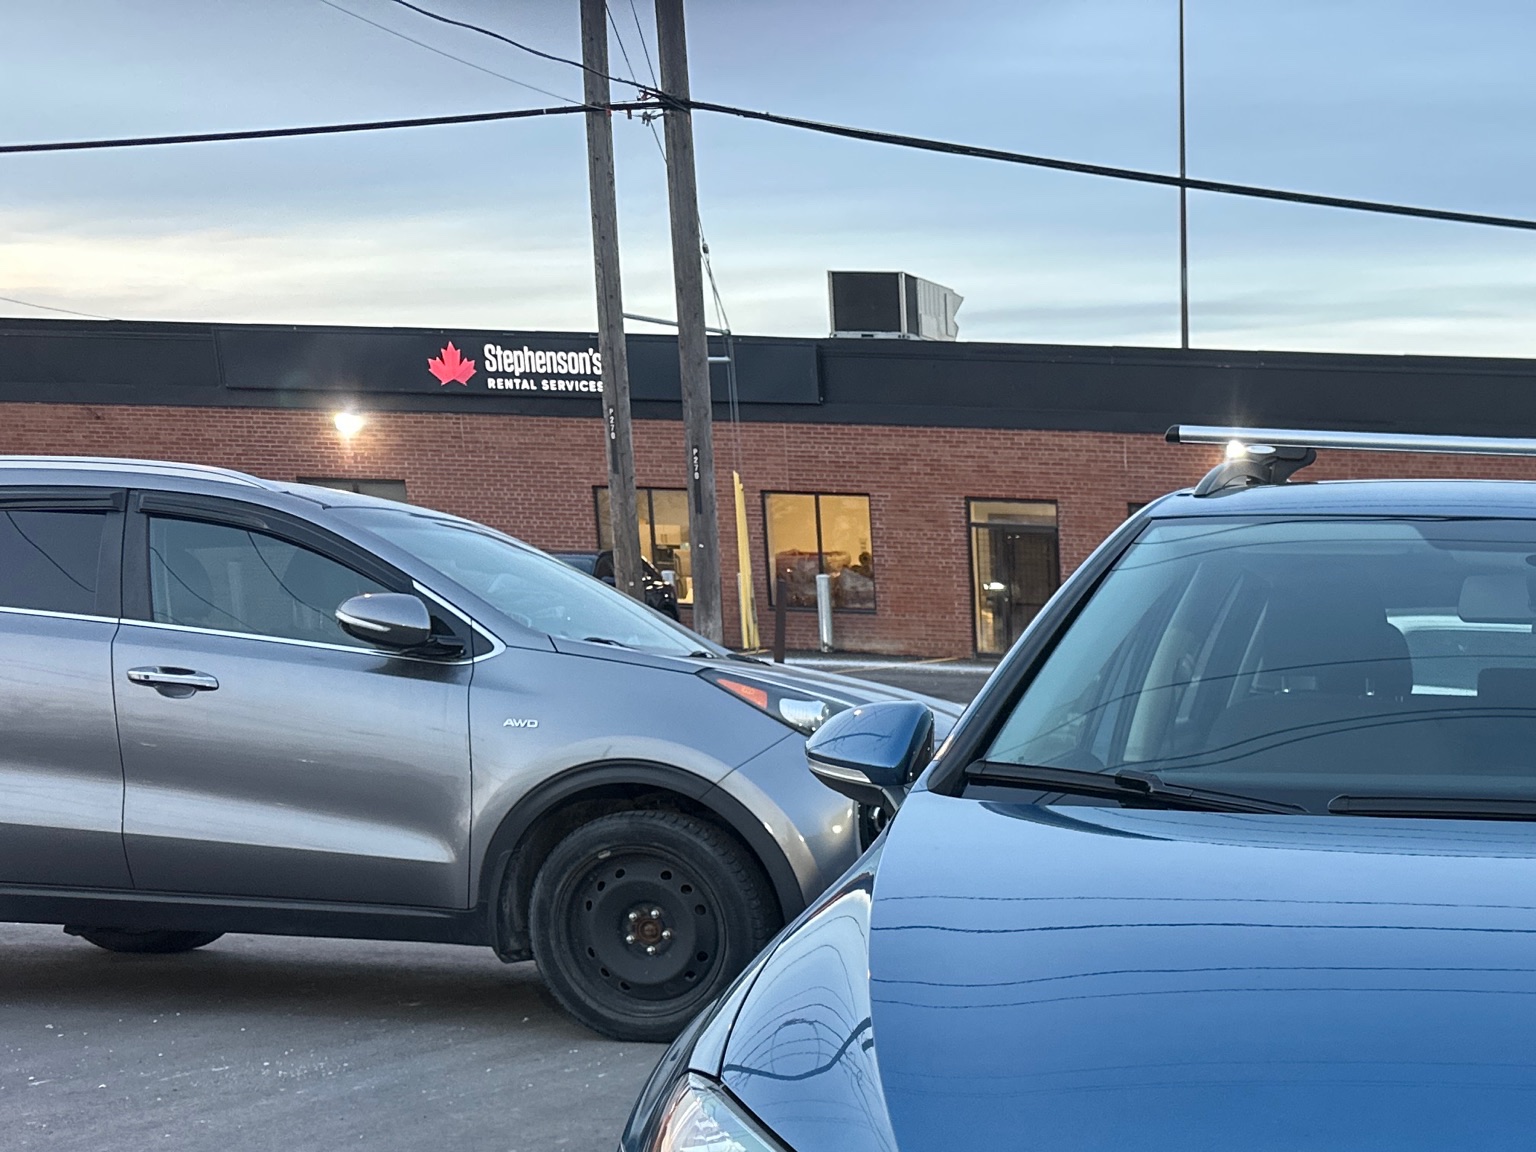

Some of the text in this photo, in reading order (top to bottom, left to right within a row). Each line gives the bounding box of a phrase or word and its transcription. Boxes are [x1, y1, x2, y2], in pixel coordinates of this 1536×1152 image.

[483, 343, 603, 376] Stephenson's
[487, 378, 604, 393] RENTAL SERVICES
[502, 718, 539, 728] AWD
